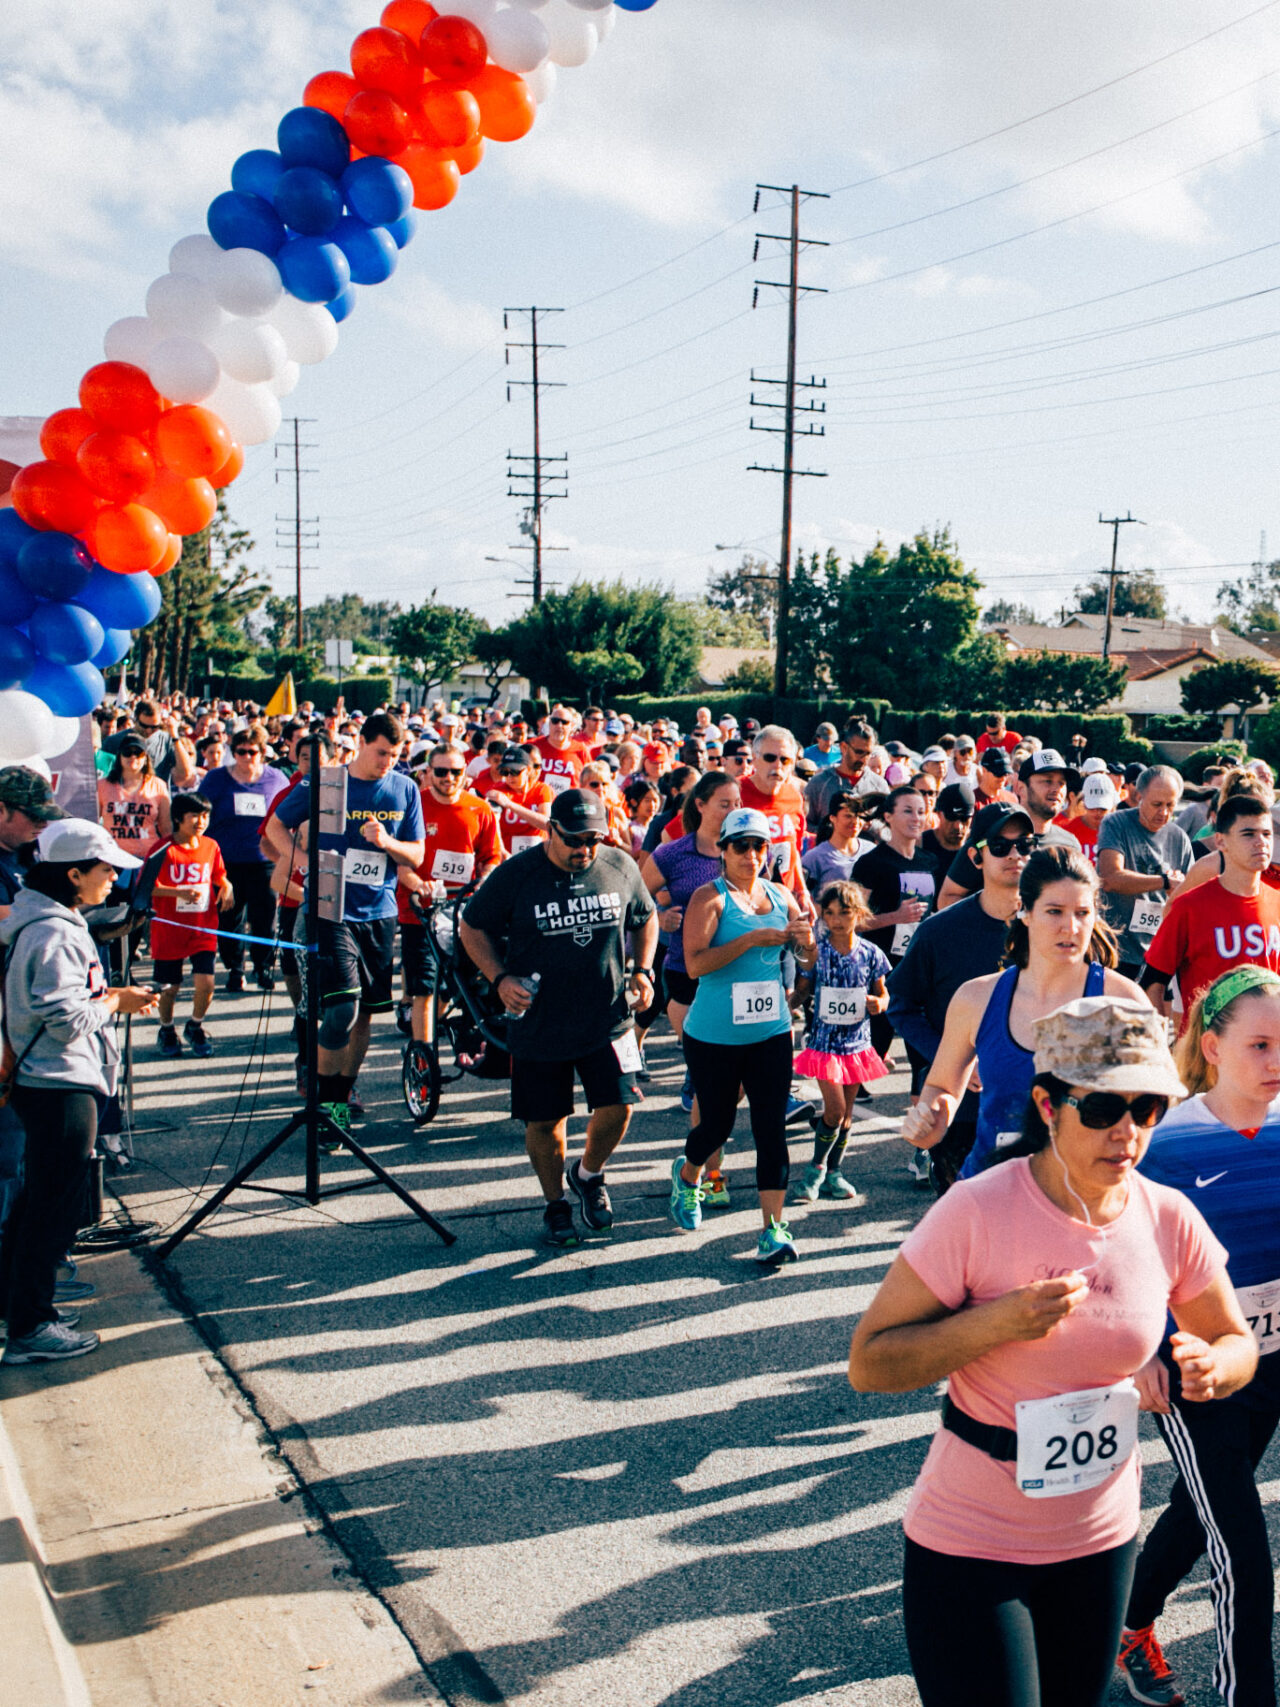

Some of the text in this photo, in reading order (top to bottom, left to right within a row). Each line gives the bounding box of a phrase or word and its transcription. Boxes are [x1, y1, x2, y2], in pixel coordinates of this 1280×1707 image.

[541, 758, 575, 775] USA
[107, 801, 153, 815] SWEAT
[344, 809, 405, 821] ARRIORS
[112, 814, 145, 827] PAIN
[767, 813, 797, 839] SA
[110, 827, 150, 840] TRAIN
[169, 862, 210, 884] USA
[352, 862, 379, 877] 204
[441, 862, 466, 876] 519
[534, 891, 621, 919] LA KINGS
[550, 907, 622, 929] HOCKEY
[1139, 912, 1160, 927] 596
[745, 996, 773, 1013] 109
[828, 1001, 857, 1015] 504
[1044, 1424, 1118, 1472] 208
[1023, 1480, 1042, 1488] UCLA
